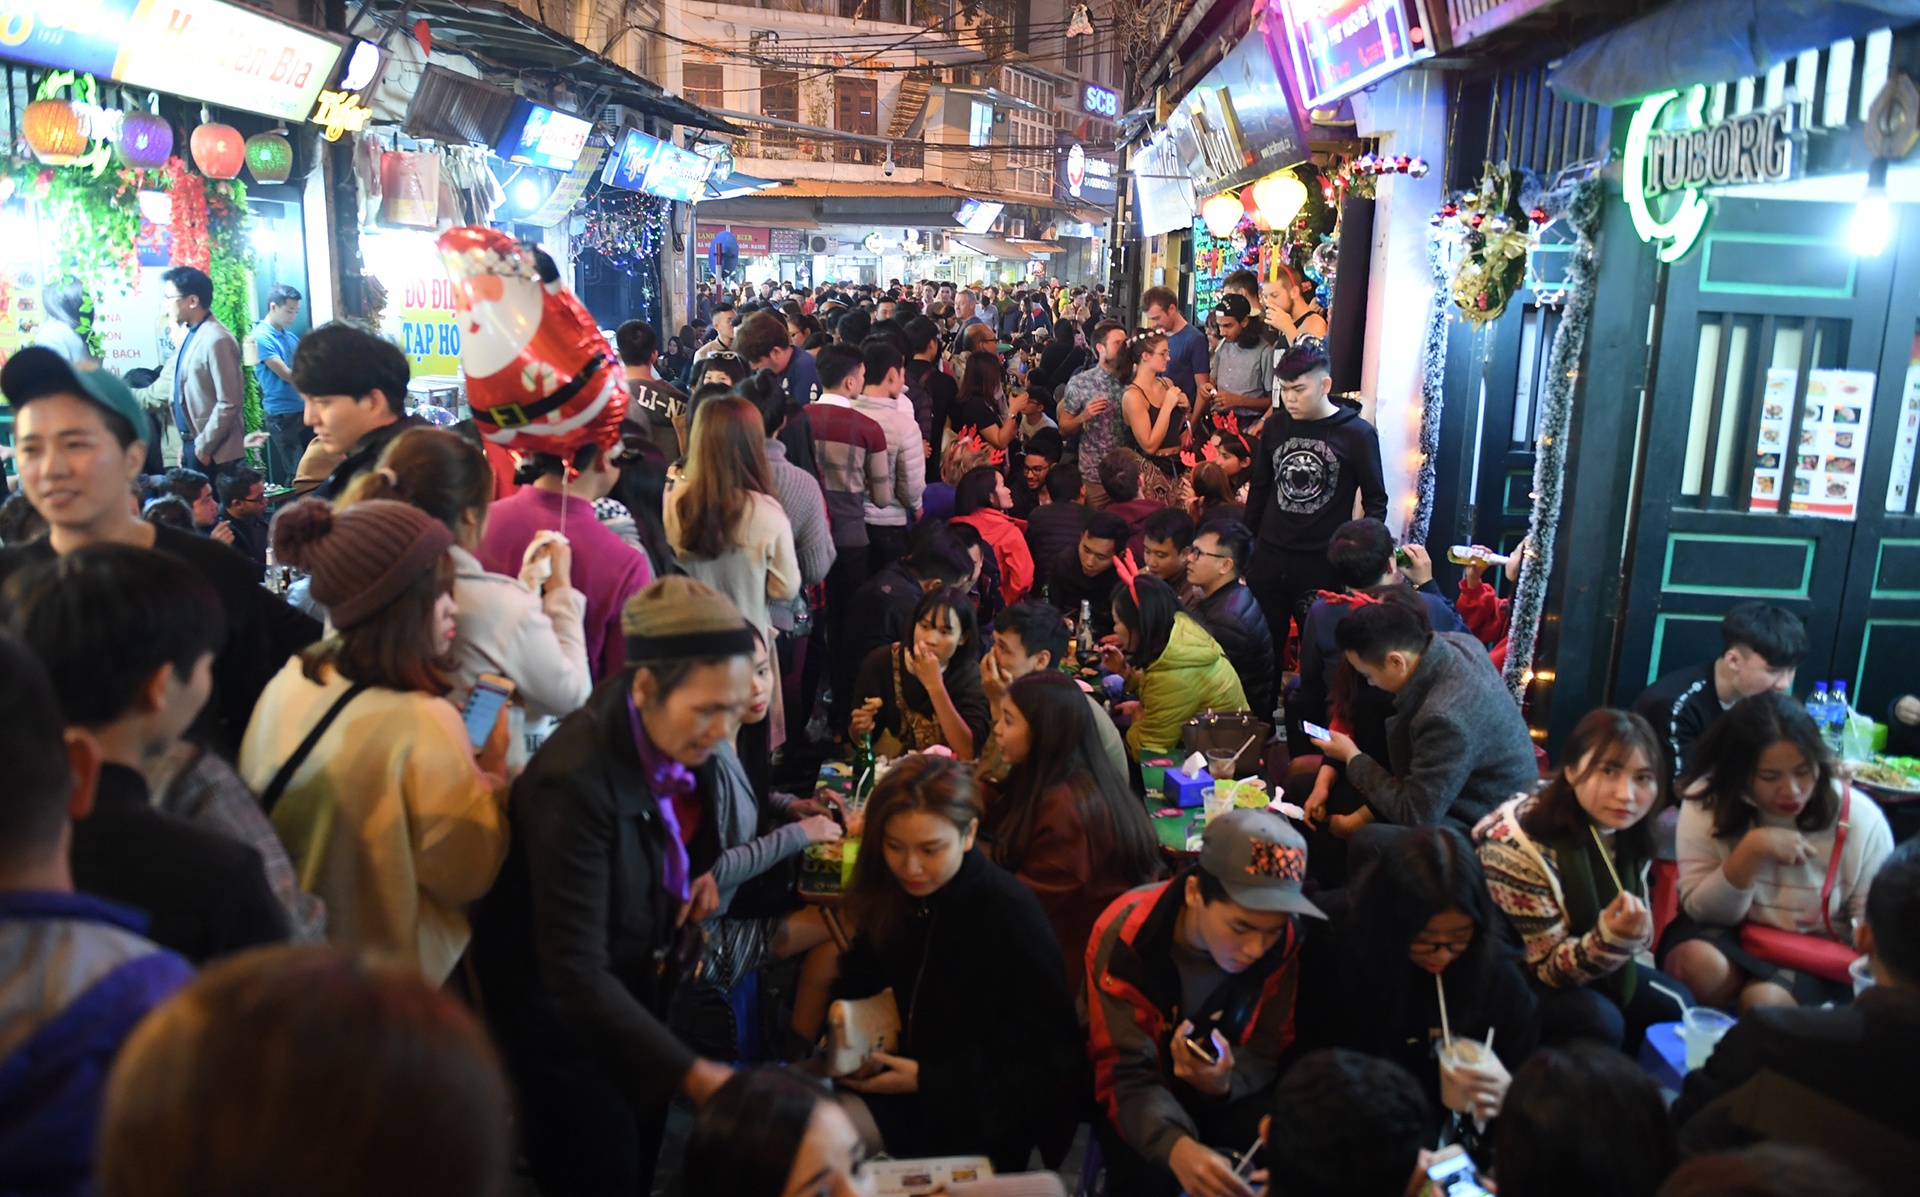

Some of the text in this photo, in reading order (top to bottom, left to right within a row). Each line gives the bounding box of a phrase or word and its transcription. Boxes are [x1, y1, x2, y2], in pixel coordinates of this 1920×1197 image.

[1086, 85, 1117, 116] SCB
[1644, 110, 1787, 198] TUBORG
[402, 322, 434, 363] TẠP
